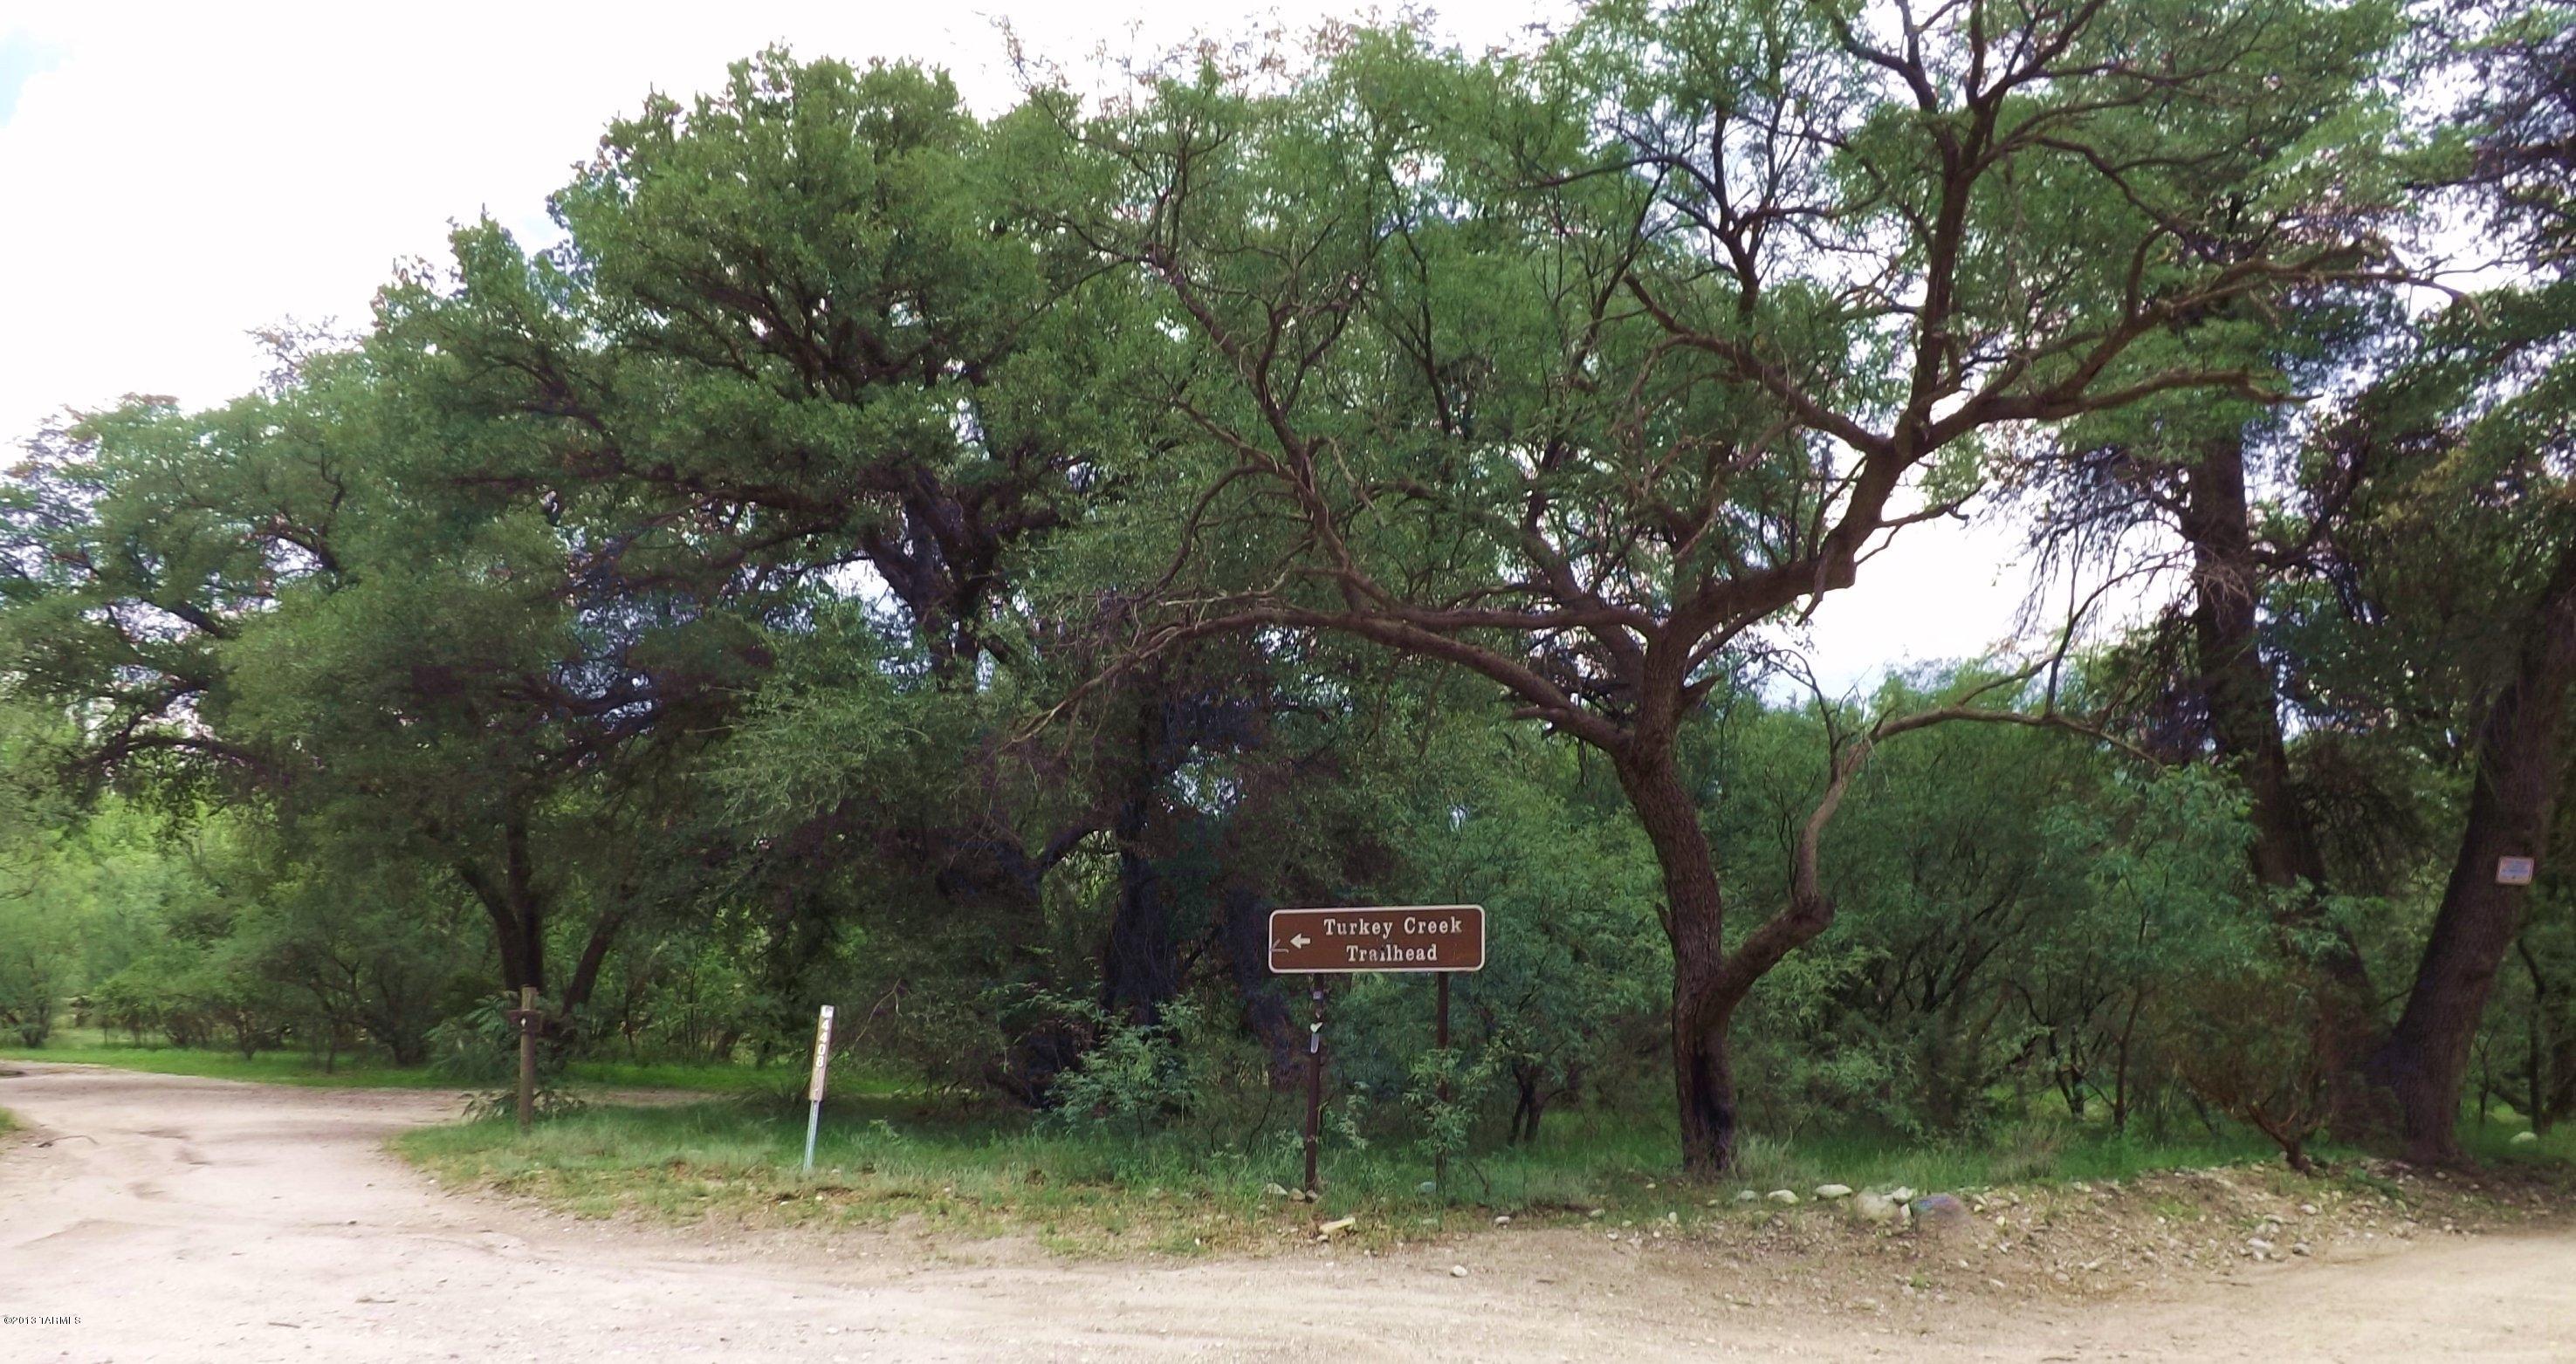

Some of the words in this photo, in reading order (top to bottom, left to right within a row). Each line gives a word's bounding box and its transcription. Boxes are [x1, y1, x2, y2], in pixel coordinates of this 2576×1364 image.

[1323, 918, 1393, 939] Turkey
[1404, 916, 1463, 934] Creek
[1346, 943, 1438, 962] Trailhead
